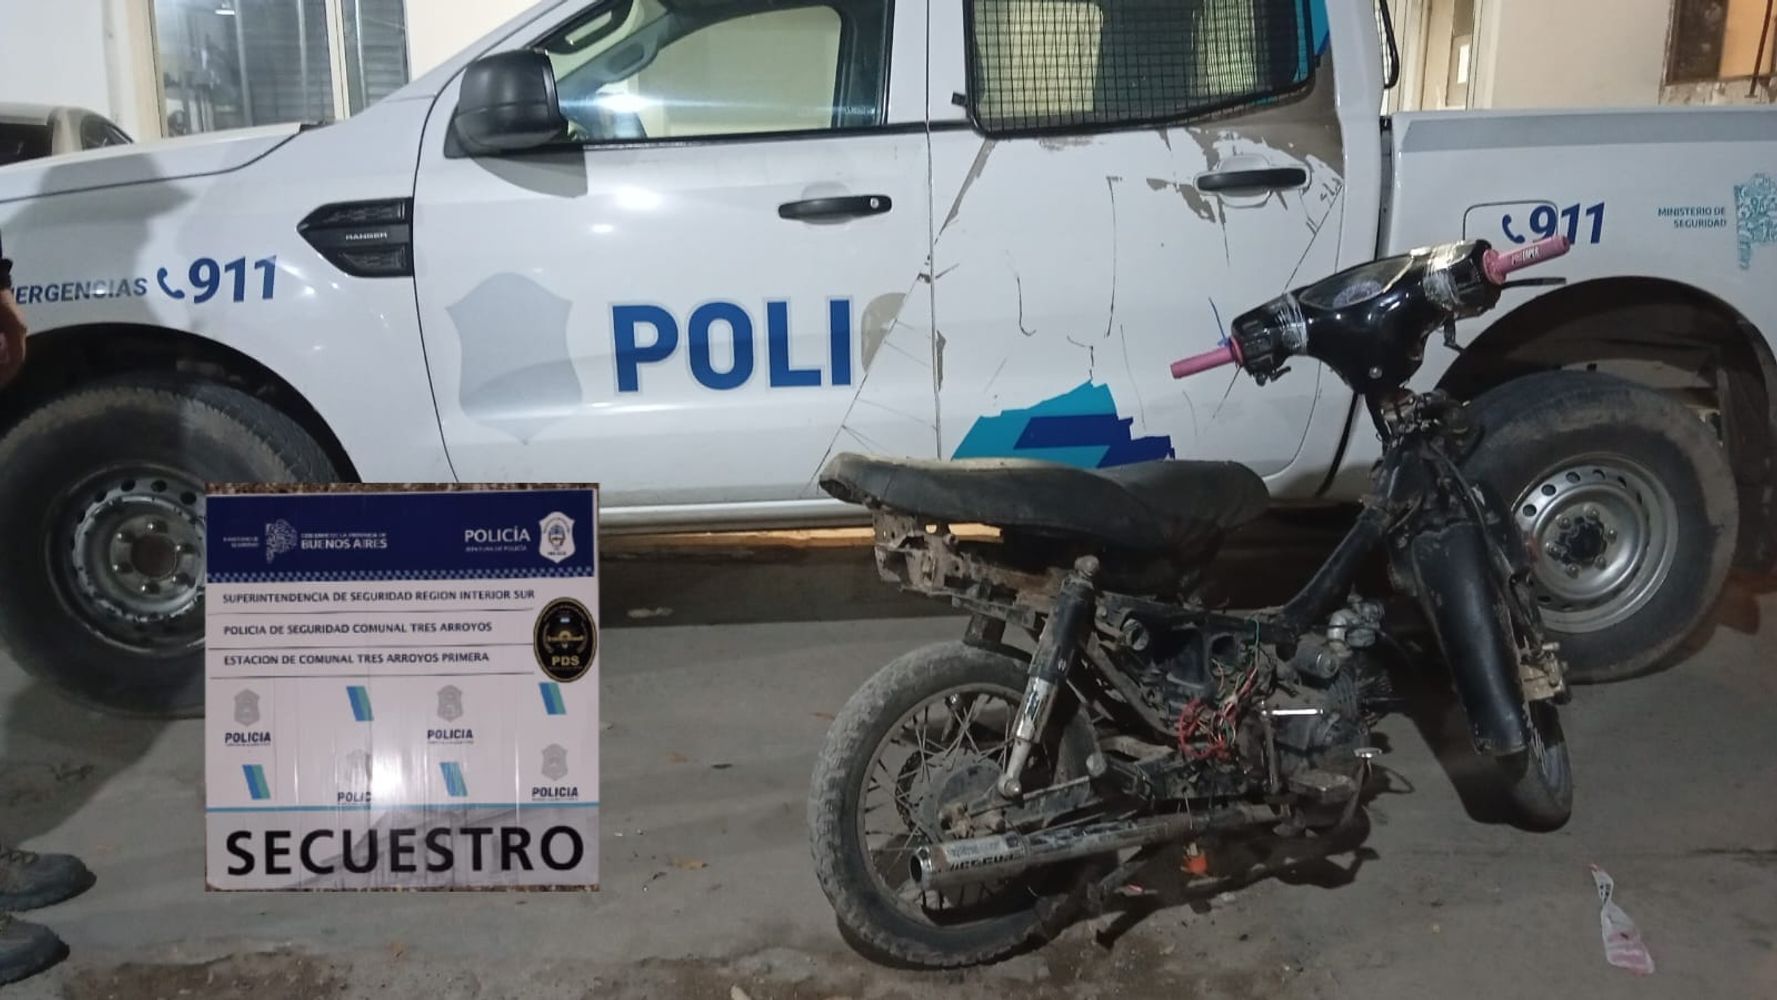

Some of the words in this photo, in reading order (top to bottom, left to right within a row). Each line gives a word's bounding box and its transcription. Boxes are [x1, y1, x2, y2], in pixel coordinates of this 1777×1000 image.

[1529, 202, 1605, 245] 911
[1657, 206, 1711, 217] MINISTERIO
[1713, 207, 1726, 216] DE
[1674, 219, 1727, 229] SEGURIDAD
[11, 277, 148, 305] ERGENCIAS
[188, 254, 278, 304] 911
